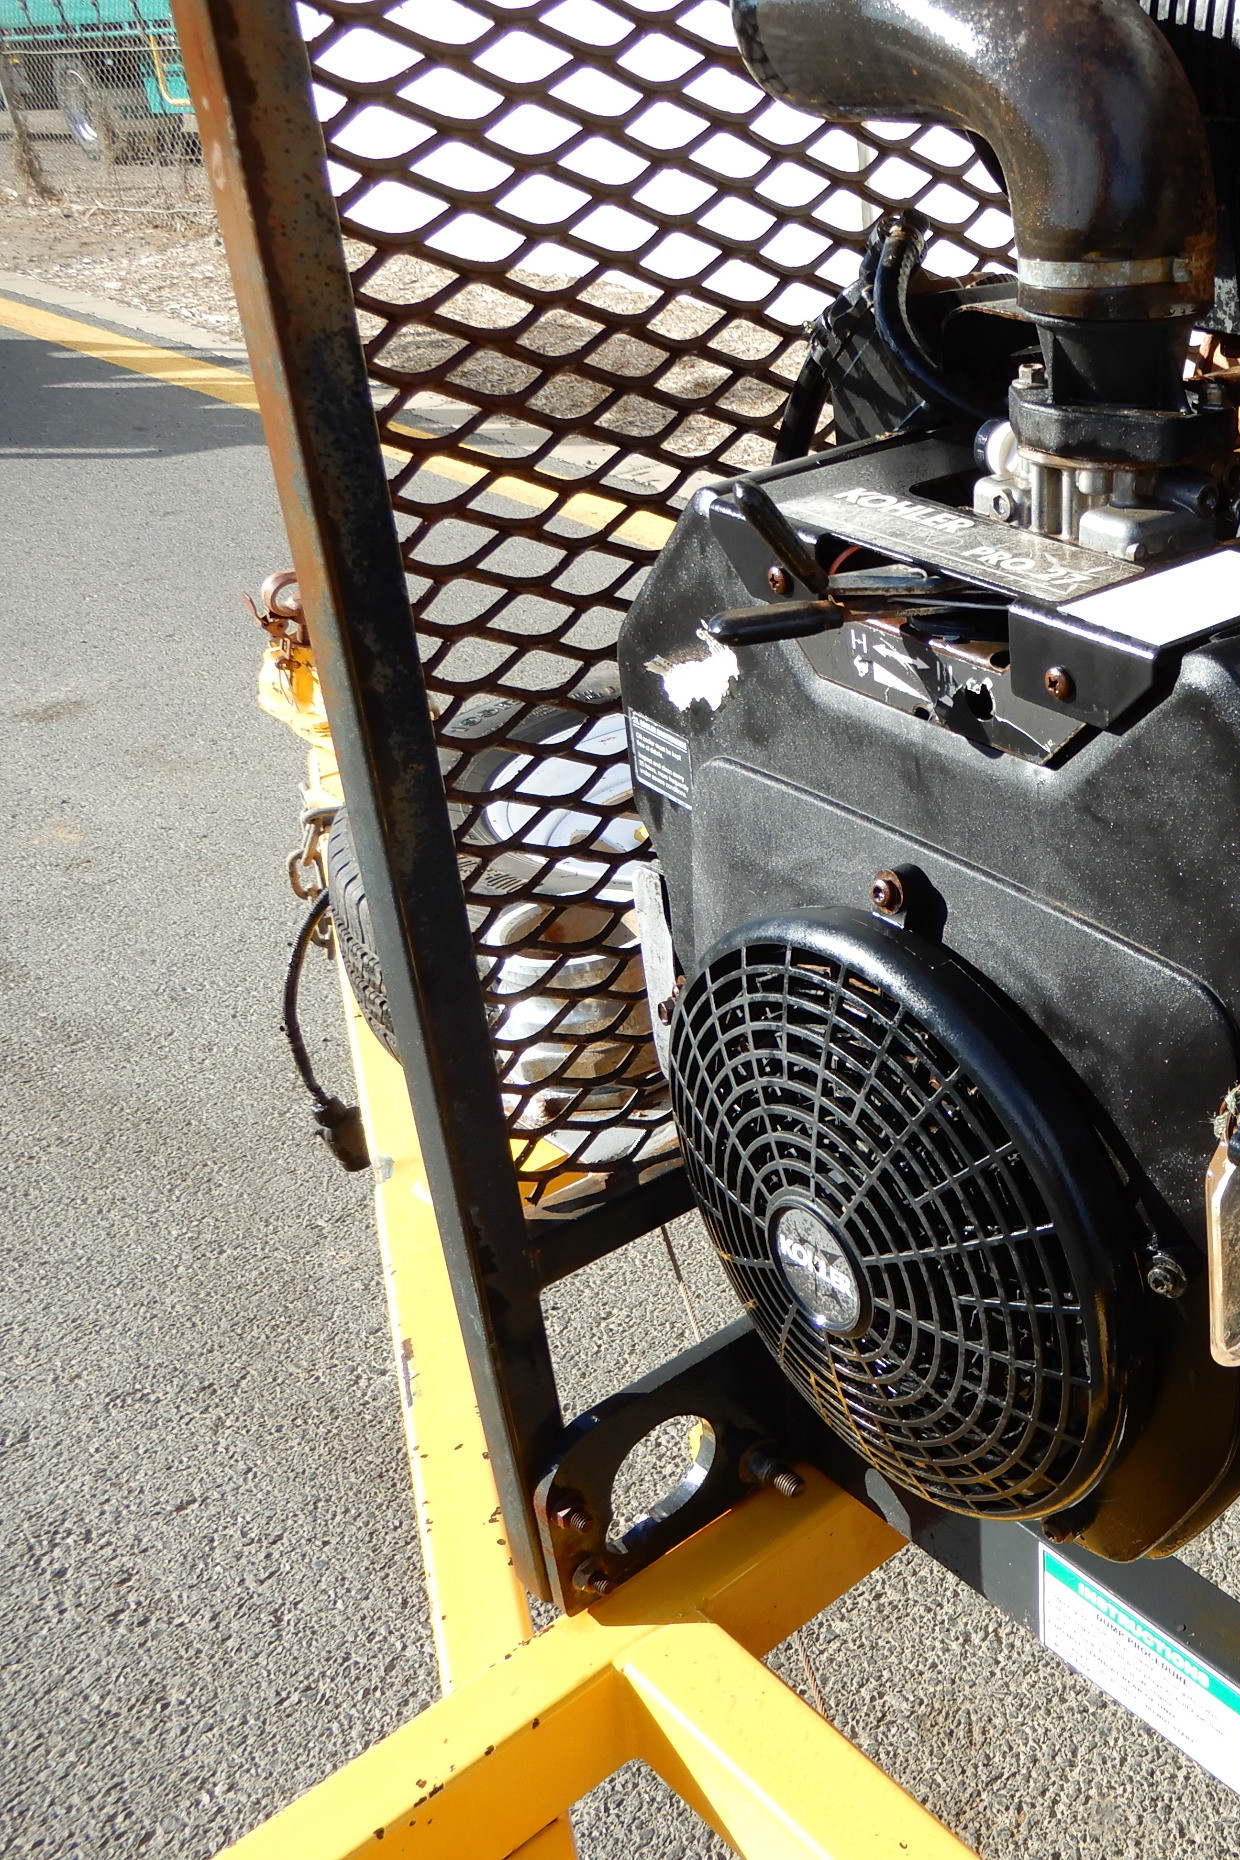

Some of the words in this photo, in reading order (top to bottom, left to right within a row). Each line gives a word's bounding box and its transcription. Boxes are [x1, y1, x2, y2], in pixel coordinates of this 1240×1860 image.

[832, 487, 975, 534] KOHLER
[960, 545, 1035, 571] PRO
[1077, 1581, 1210, 1689] INSTRUCTIONS
